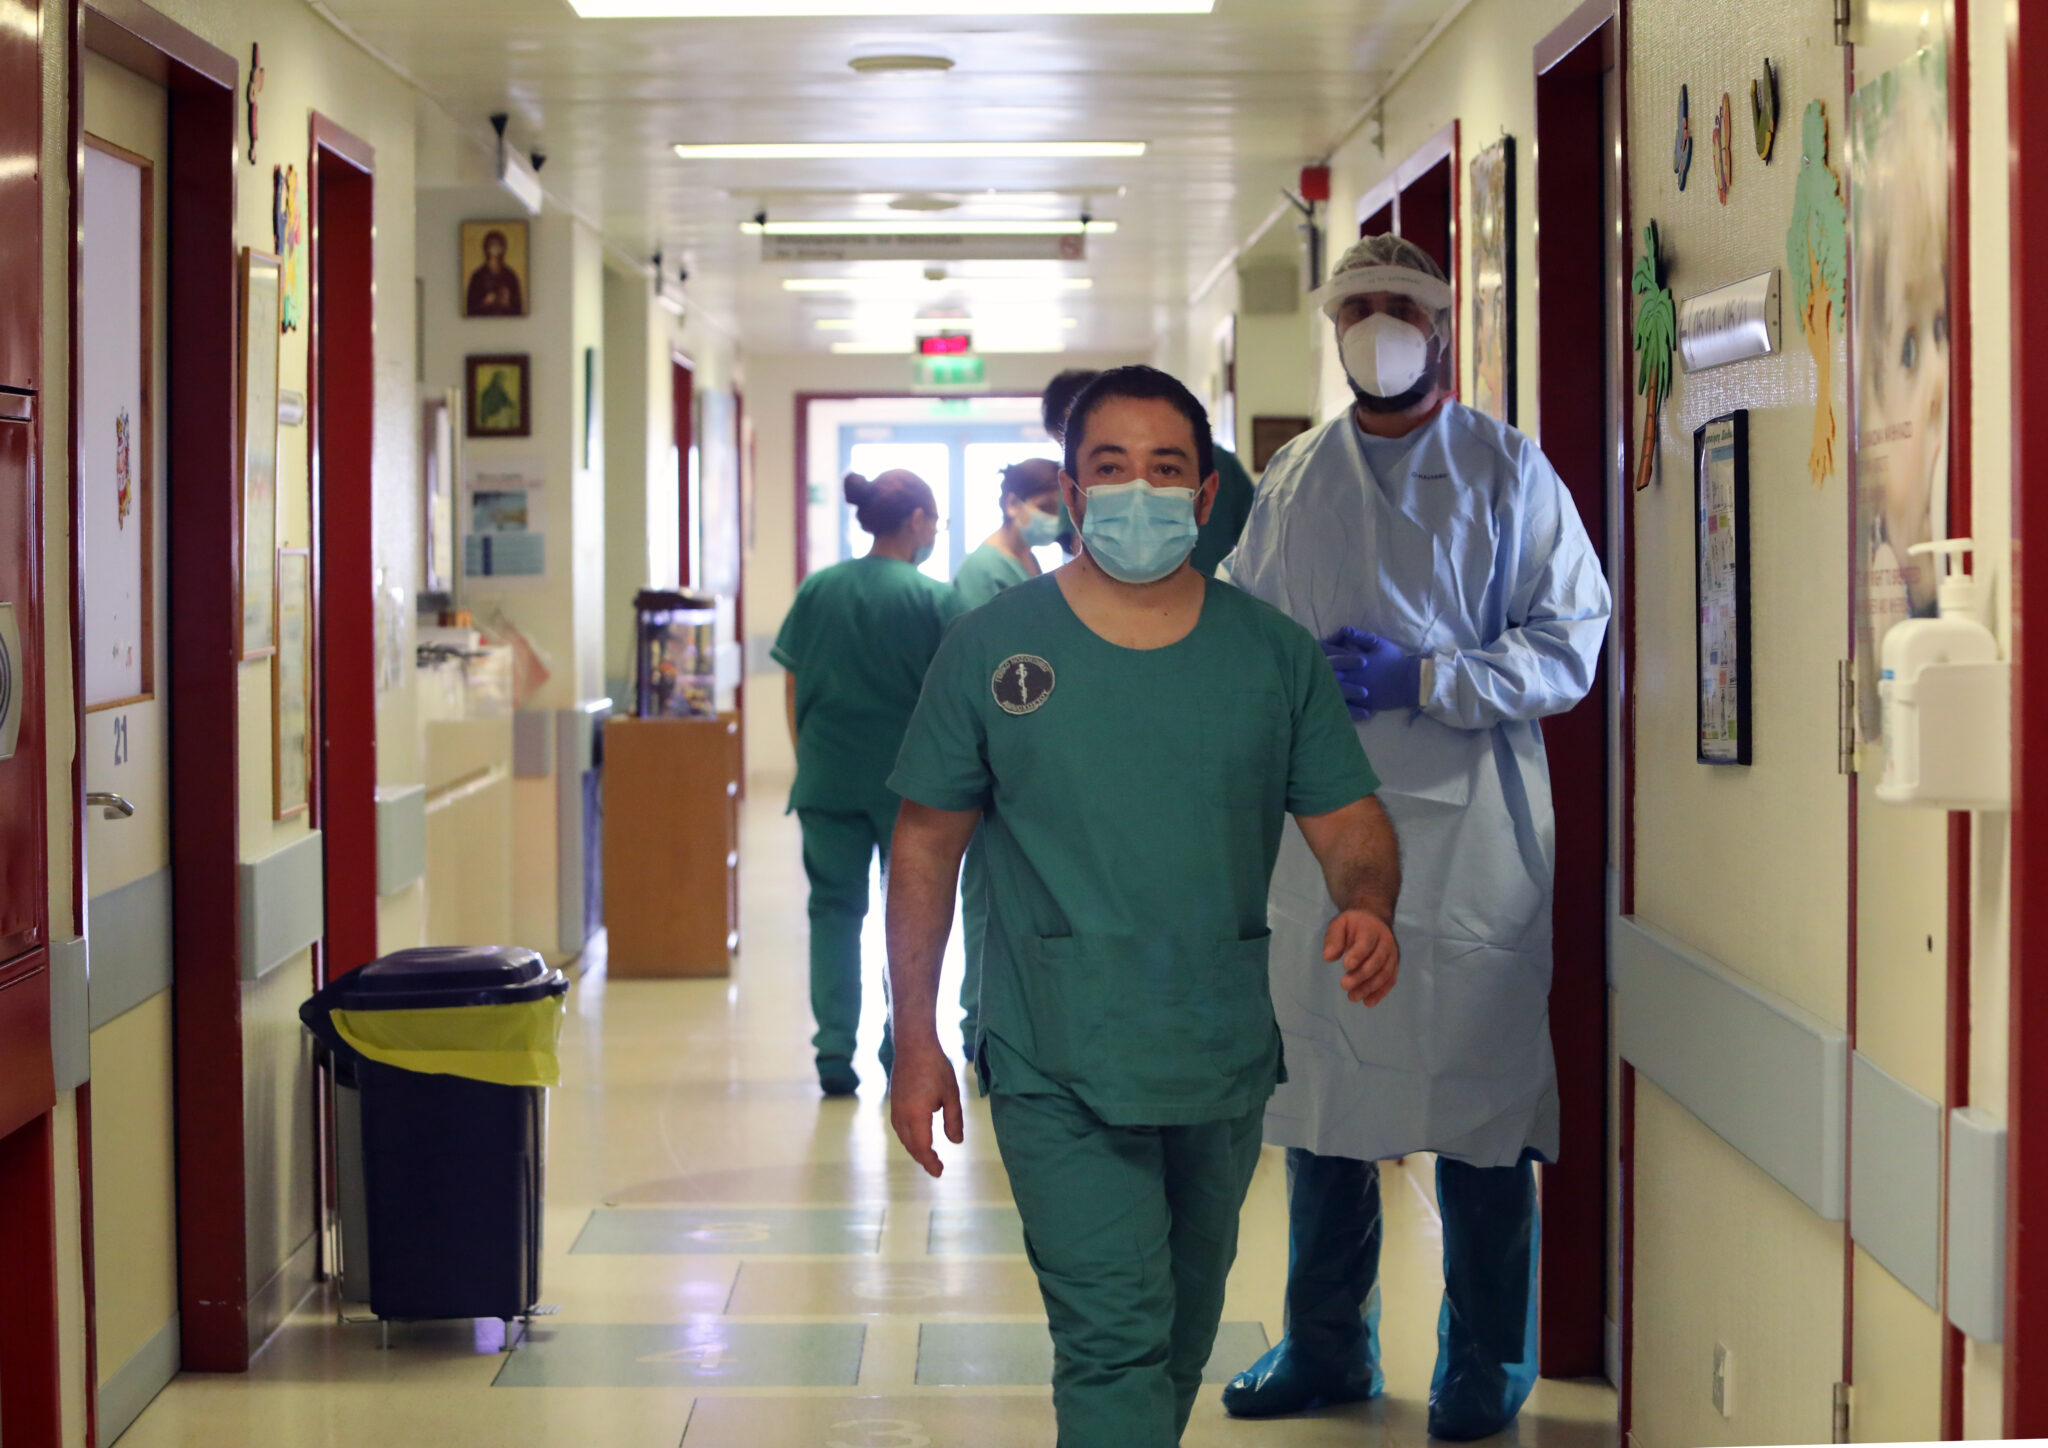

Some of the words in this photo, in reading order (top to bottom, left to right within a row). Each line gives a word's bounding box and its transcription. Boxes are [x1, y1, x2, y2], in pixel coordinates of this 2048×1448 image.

[114, 714, 128, 766] 21
[636, 1342, 739, 1369] 4
[825, 1418, 932, 1448] 3
